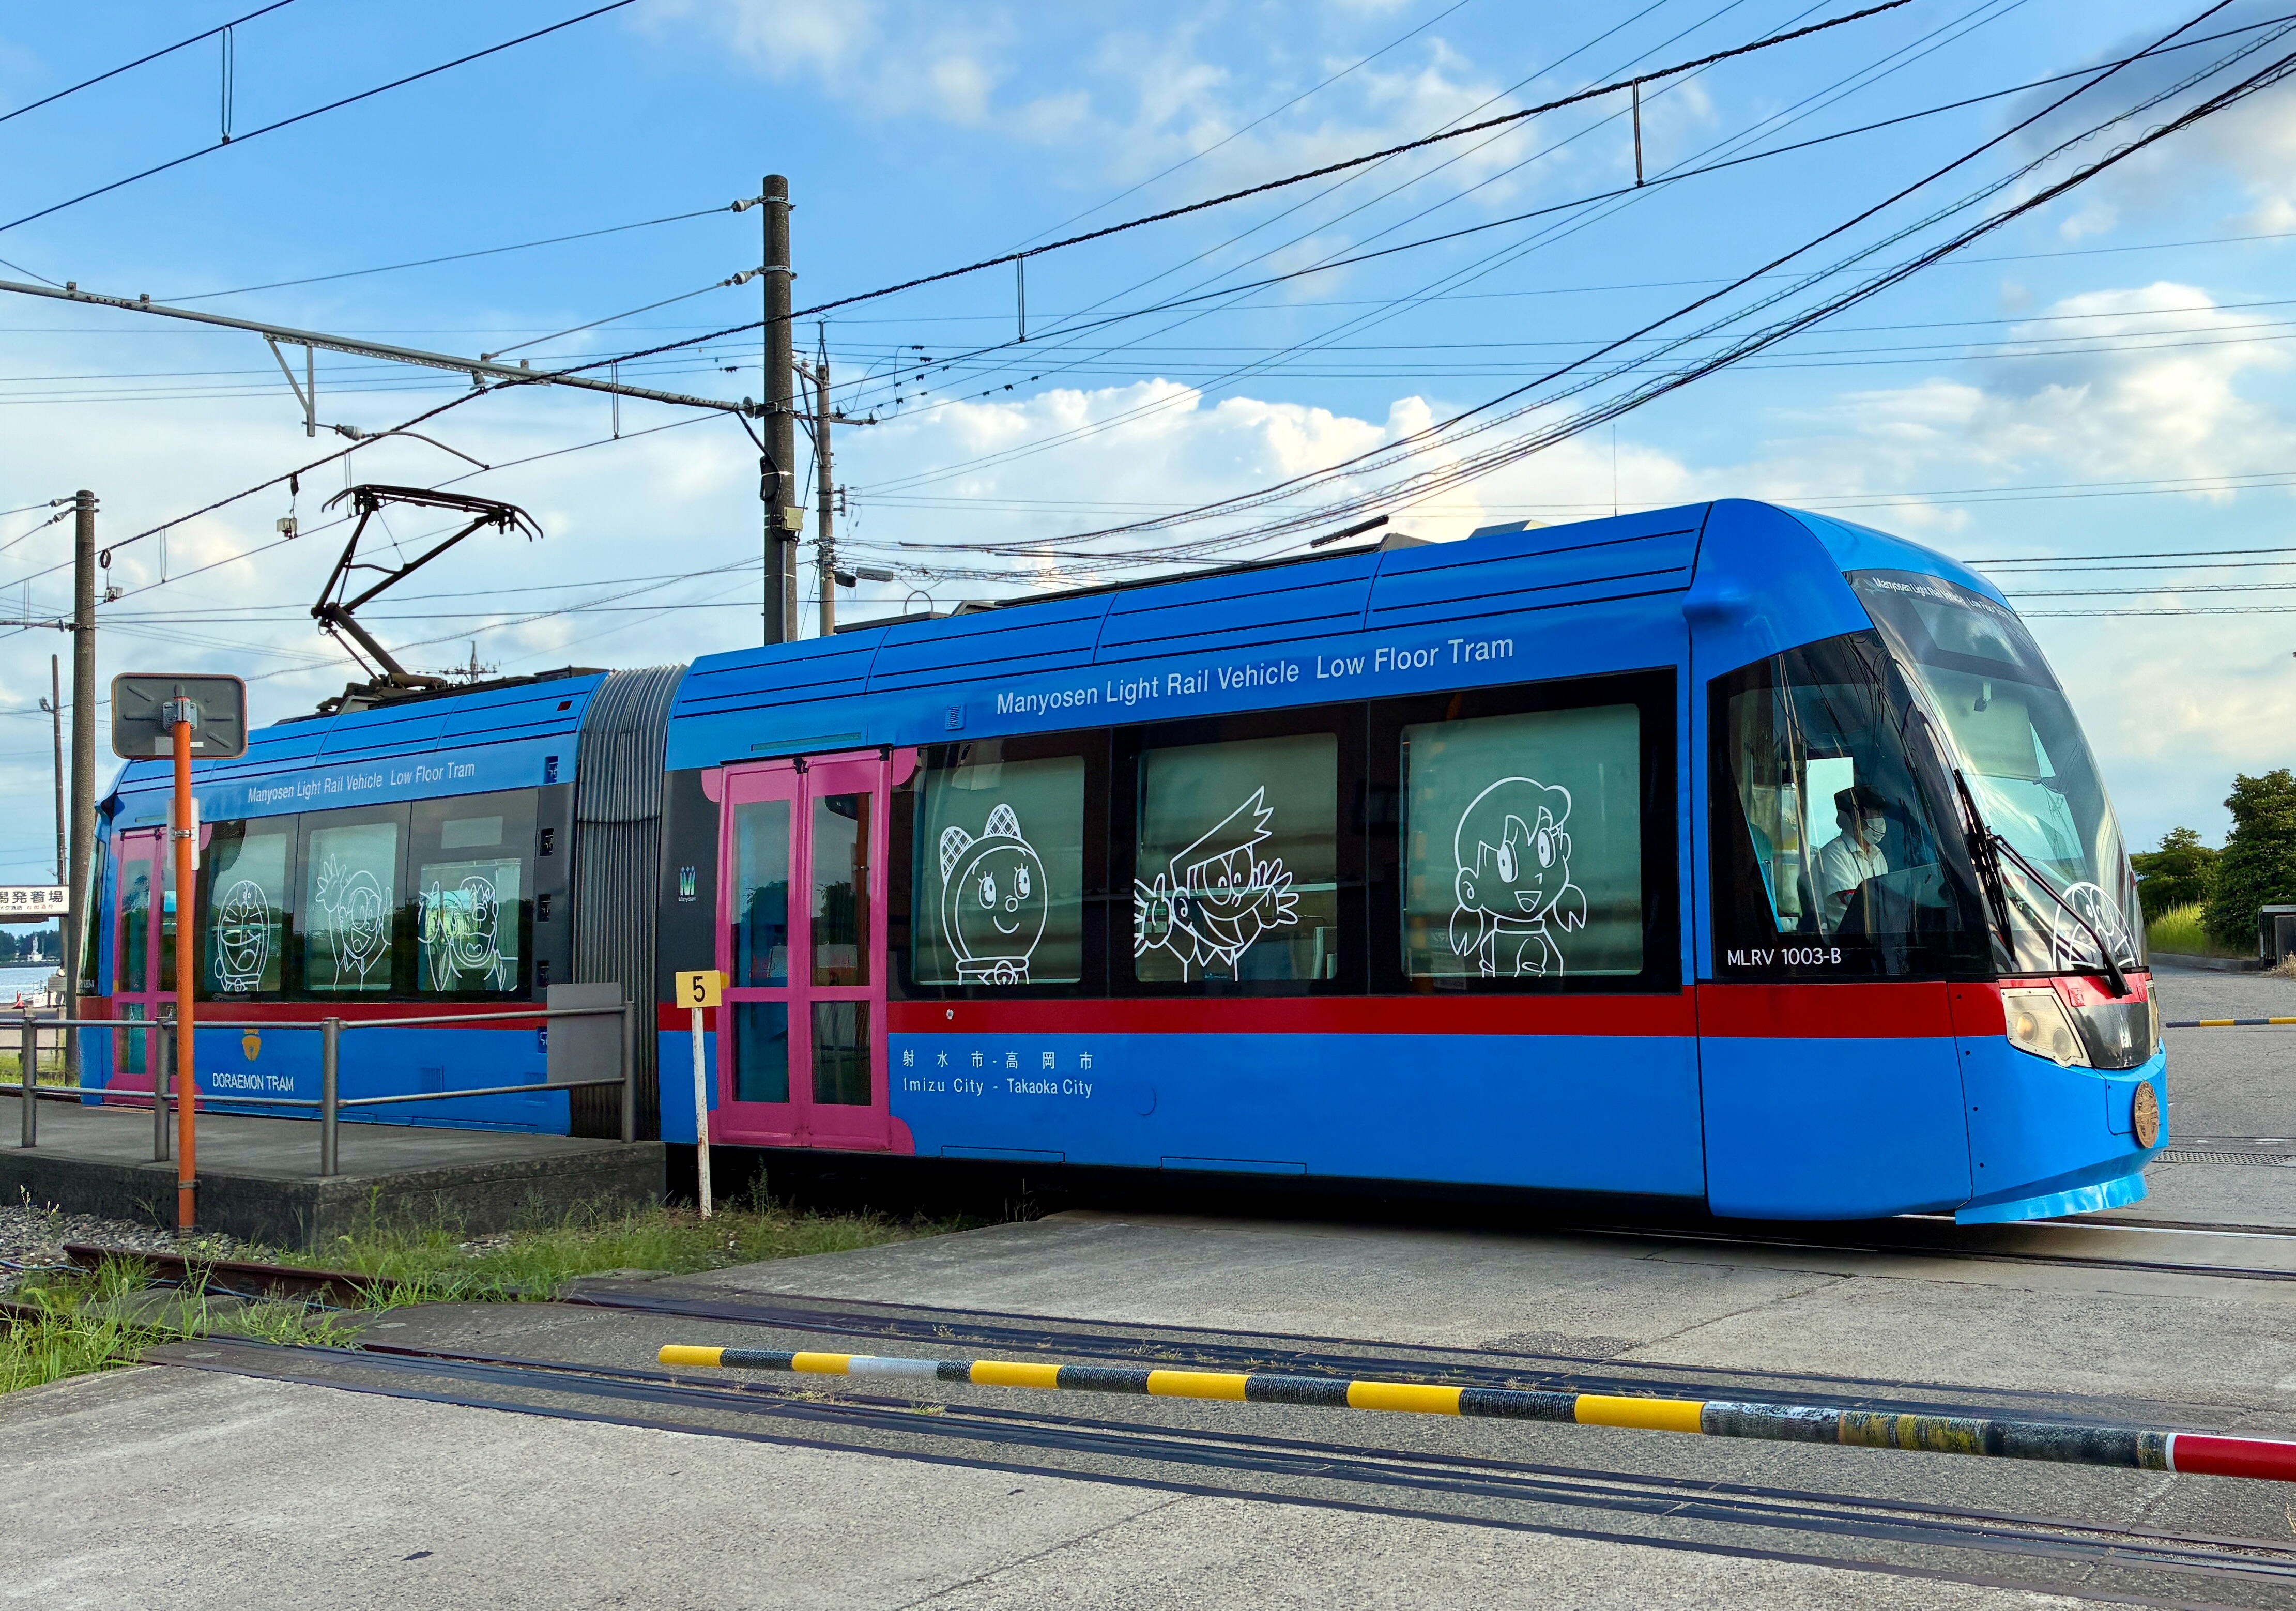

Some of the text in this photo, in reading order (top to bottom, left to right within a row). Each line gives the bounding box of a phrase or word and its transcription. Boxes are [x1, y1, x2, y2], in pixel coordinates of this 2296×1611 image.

[997, 638, 1513, 715] Manyosen Light Rail Vehicle Low Floor Tram
[248, 761, 475, 804] Manyosen Light Rail Vehicle Low Floor Tram
[1727, 947, 1841, 966] MLRV 1003-B
[693, 976, 705, 1002] 5
[212, 1072, 294, 1092] DORAEMON TRAM
[904, 1077, 945, 1092] Imizu
[954, 1078, 983, 1096] City
[1006, 1078, 1059, 1094] Takaoka
[1063, 1079, 1093, 1099] City
